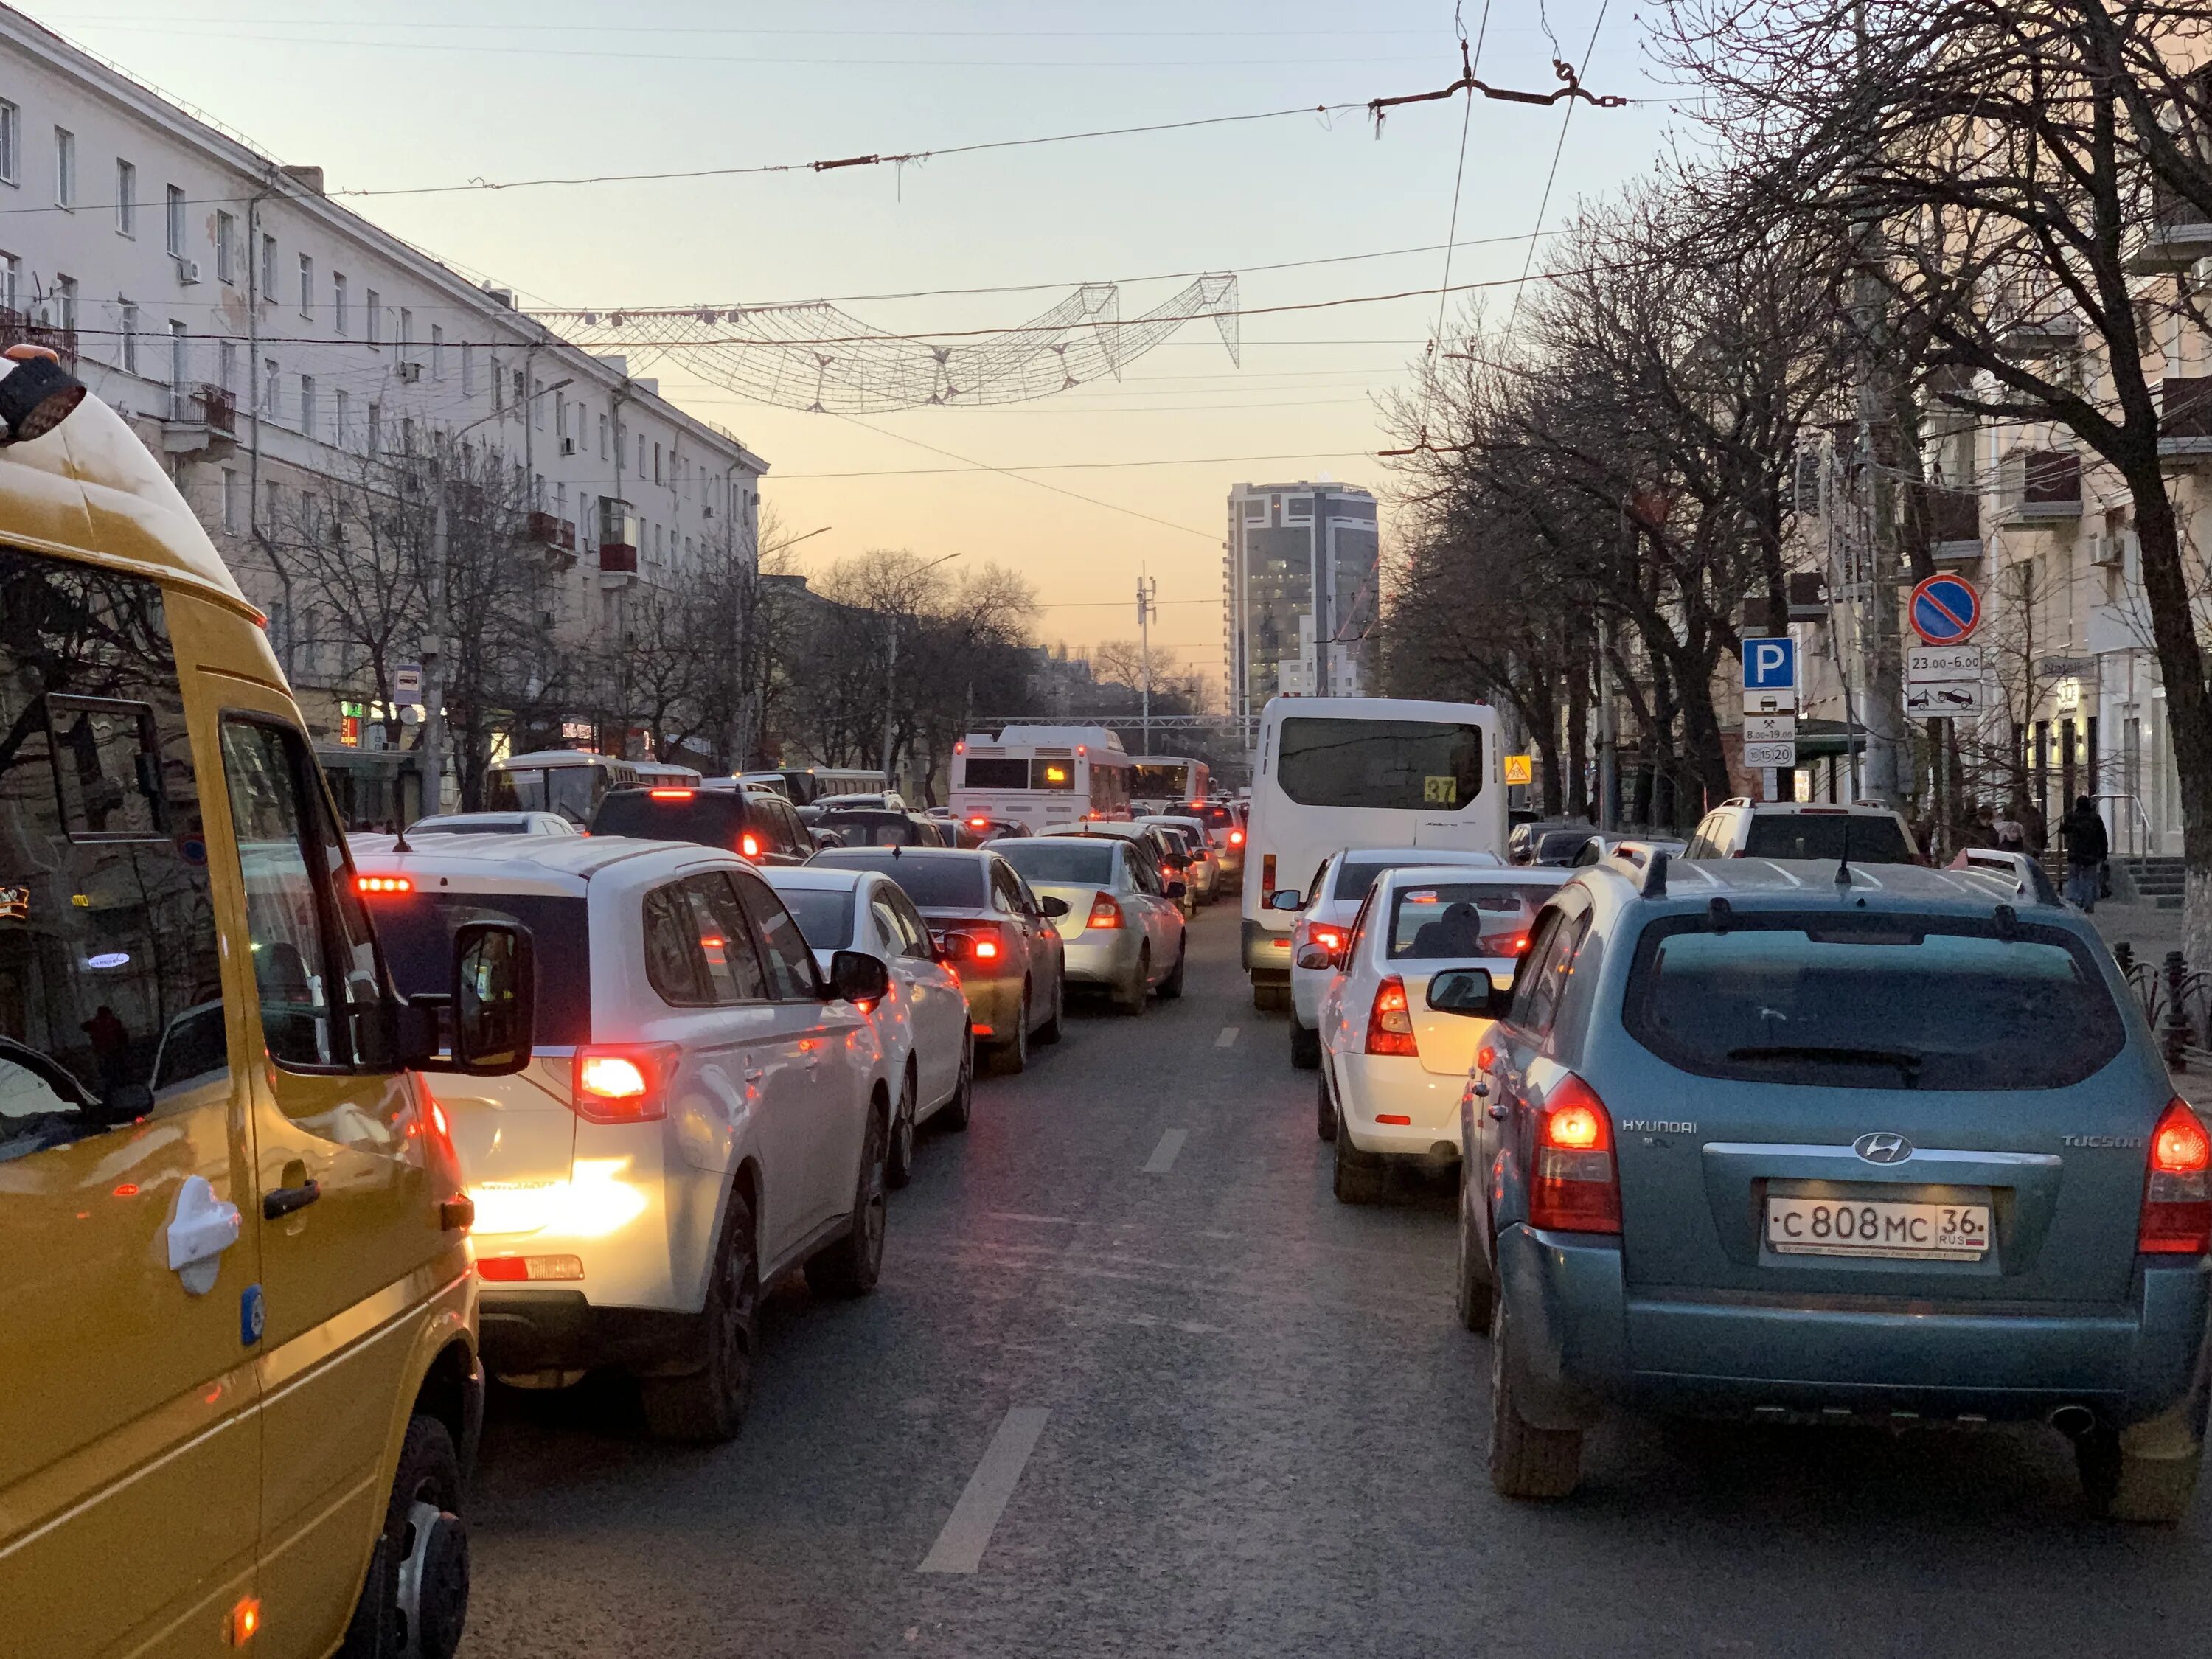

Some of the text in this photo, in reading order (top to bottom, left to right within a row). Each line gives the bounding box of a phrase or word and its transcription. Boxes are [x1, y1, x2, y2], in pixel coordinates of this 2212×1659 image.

[1757, 644, 1784, 683] P
[1913, 656, 1979, 669] 23.00-6.00
[1761, 751, 1771, 759] 15
[1775, 749, 1790, 760] 20
[1427, 779, 1454, 801] 37
[1622, 1119, 1697, 1133] HYUNDAI
[1939, 1235, 1965, 1245] RUS
